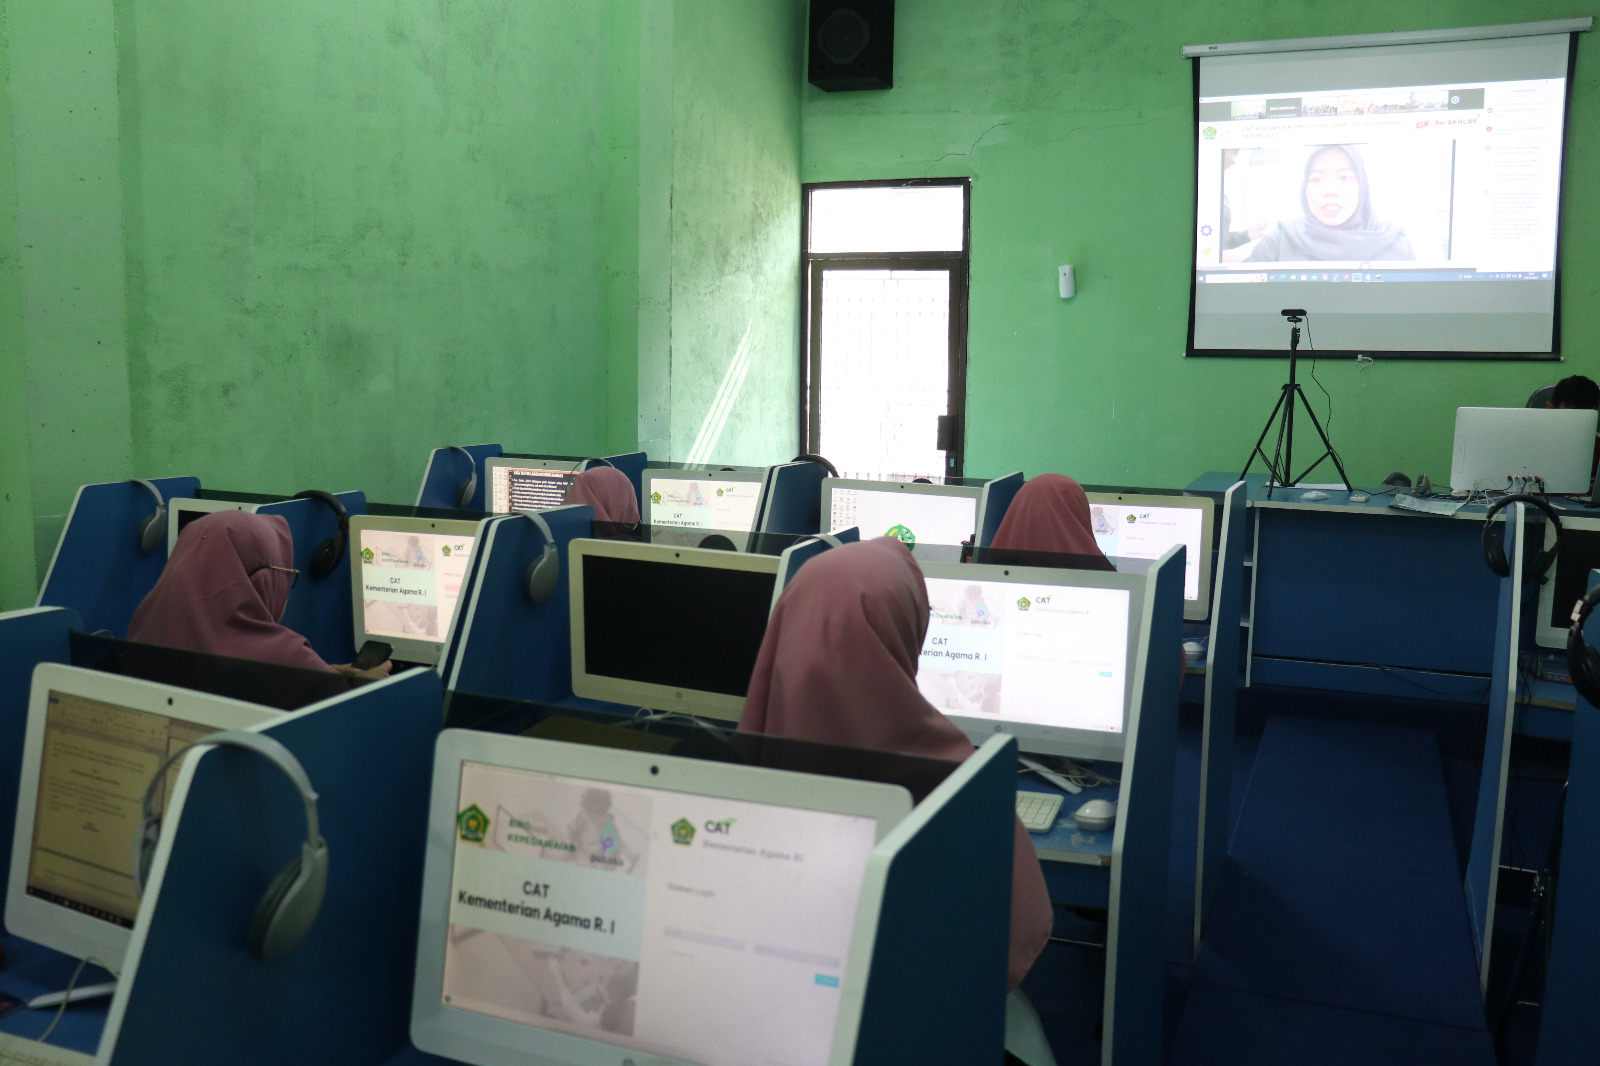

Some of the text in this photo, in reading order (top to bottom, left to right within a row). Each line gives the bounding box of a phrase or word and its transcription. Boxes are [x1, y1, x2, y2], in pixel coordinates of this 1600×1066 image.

[1434, 118, 1478, 126] BerAKHLAK
[390, 577, 401, 585] CAT
[365, 584, 399, 595] Kementerian
[400, 587, 418, 597] Agama
[1035, 596, 1051, 604] CAT
[932, 637, 949, 646] CAT
[945, 650, 973, 661] Agama
[704, 820, 732, 835] CAT
[523, 880, 551, 899] CAT
[457, 889, 541, 920] Kementerian
[543, 907, 591, 928] Agama
[593, 917, 607, 933] R.
